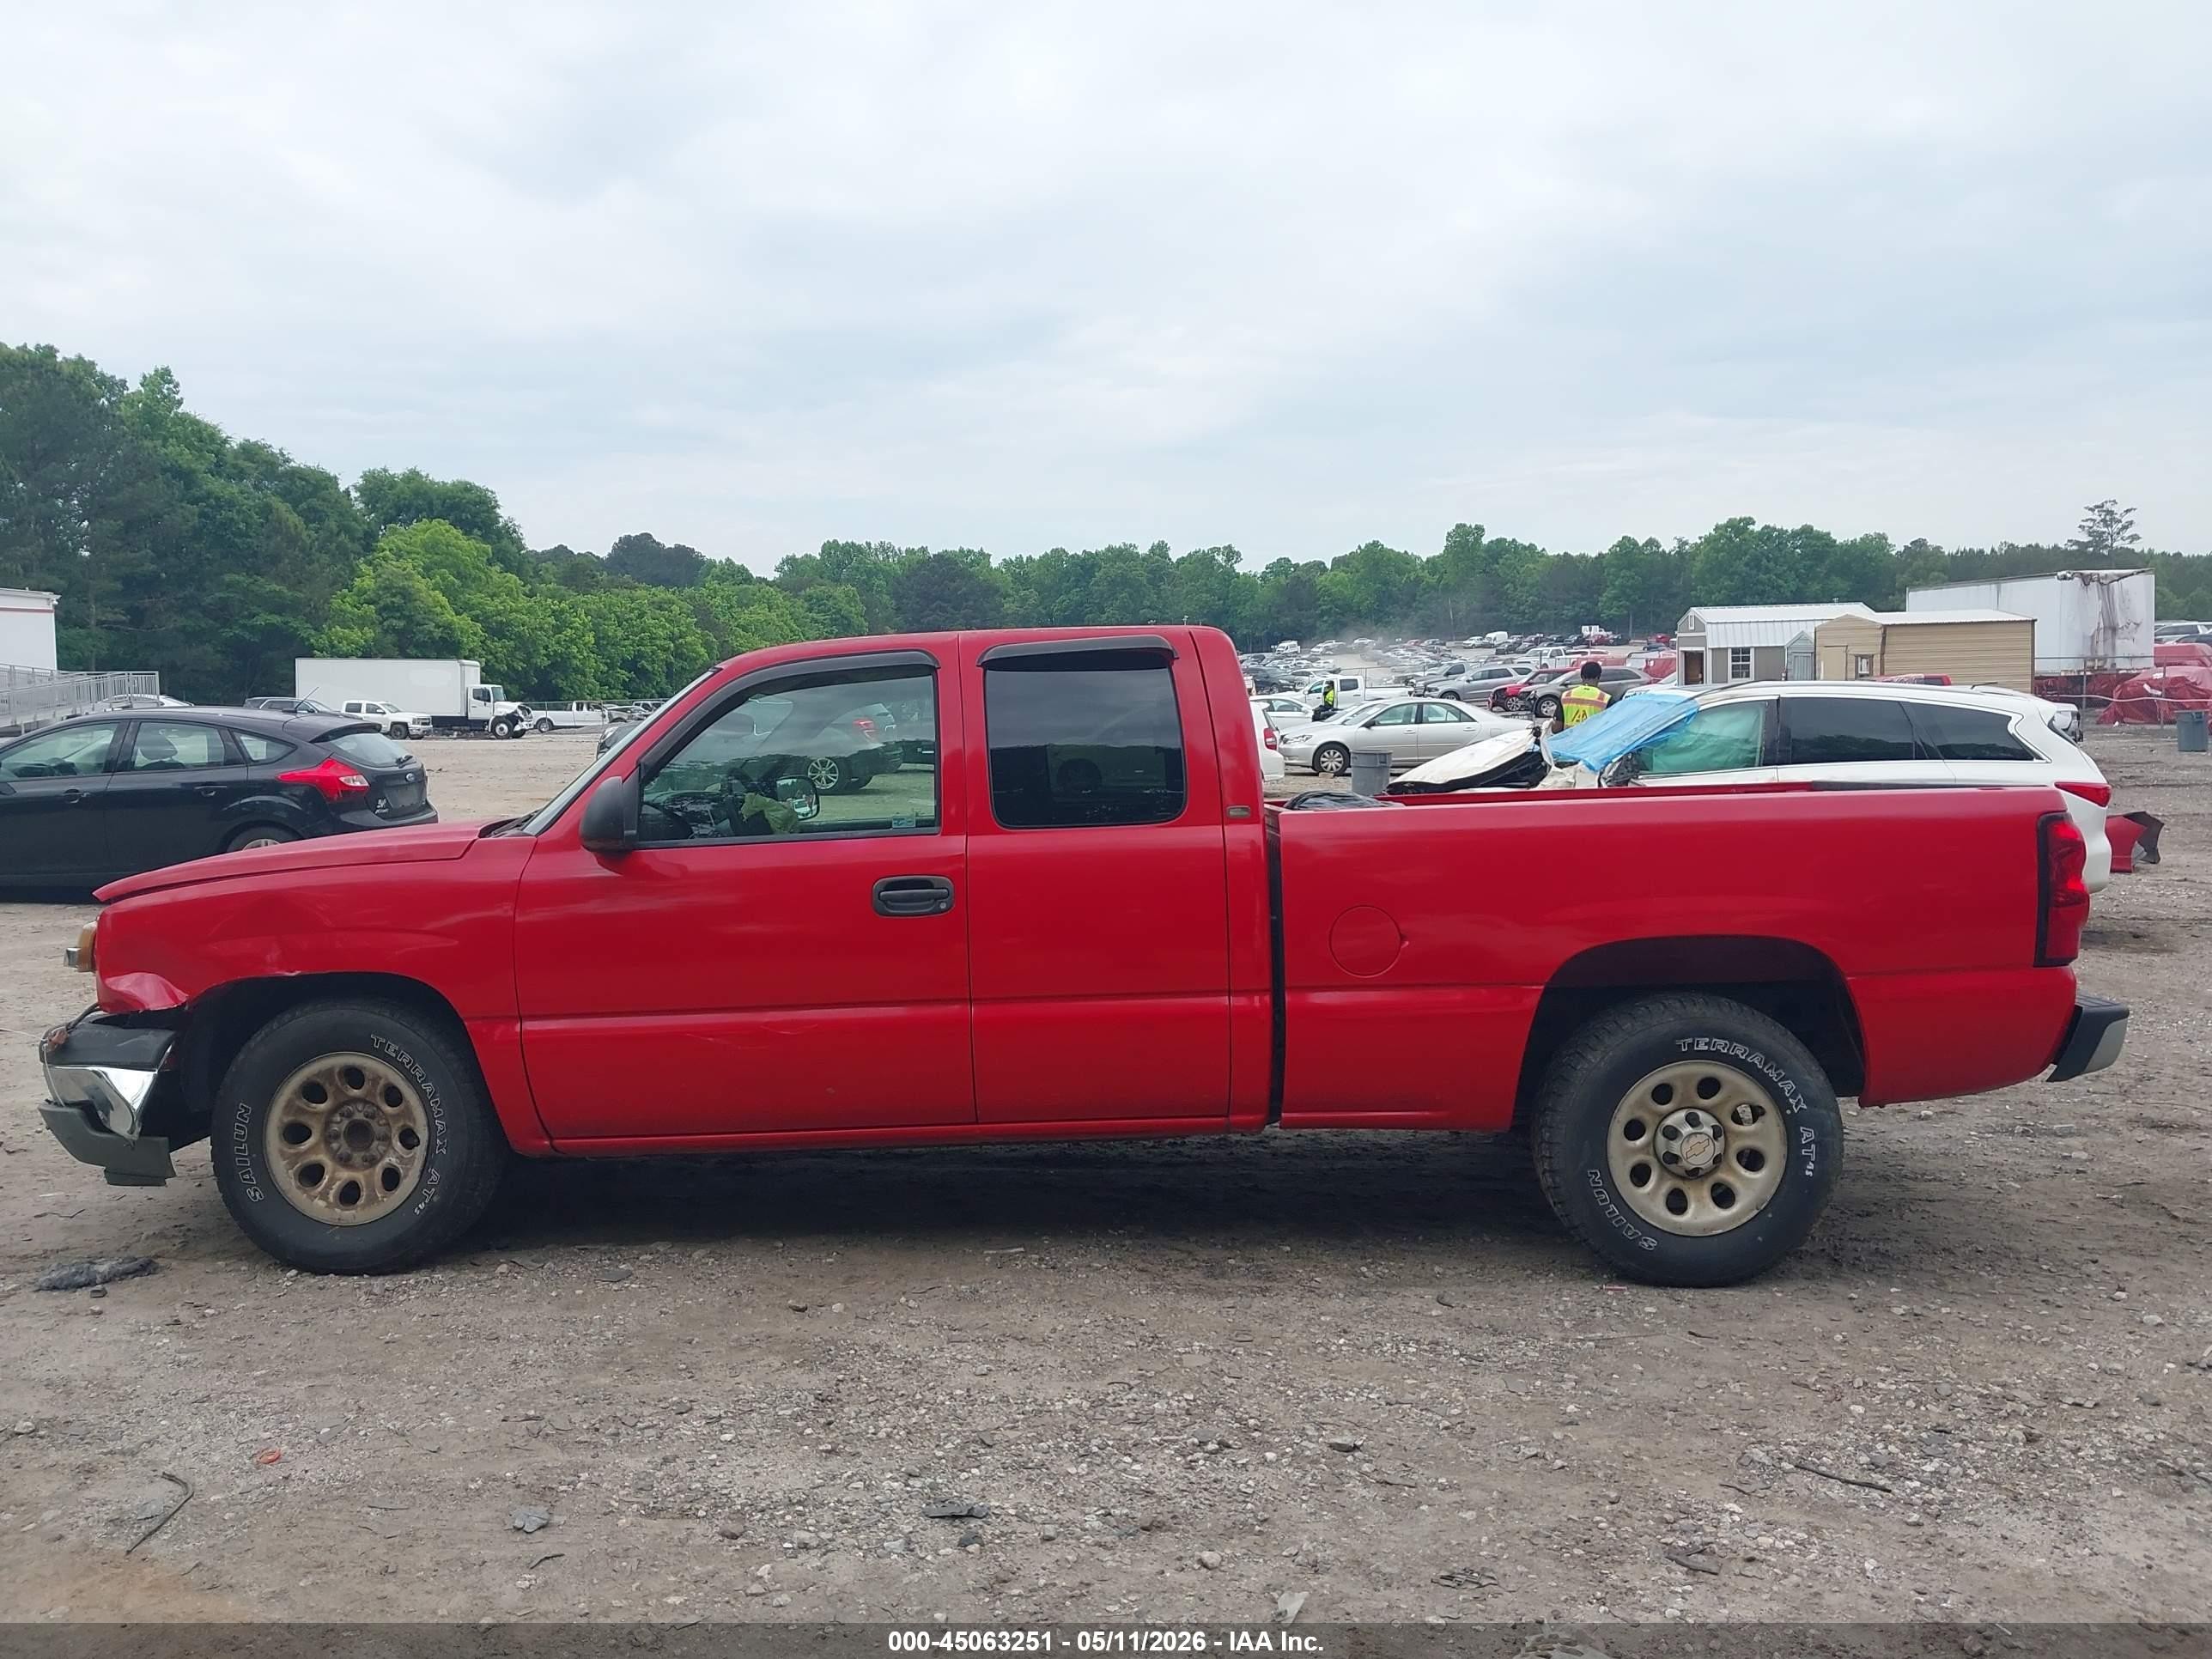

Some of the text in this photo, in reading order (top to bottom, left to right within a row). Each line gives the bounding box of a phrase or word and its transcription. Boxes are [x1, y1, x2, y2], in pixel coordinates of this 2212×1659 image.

[370, 1033, 447, 1155] TERRAMAX
[1675, 1037, 1808, 1113] TERRAMAX
[234, 1103, 264, 1202] SAILUN
[1587, 1169, 1658, 1251] SAILUN
